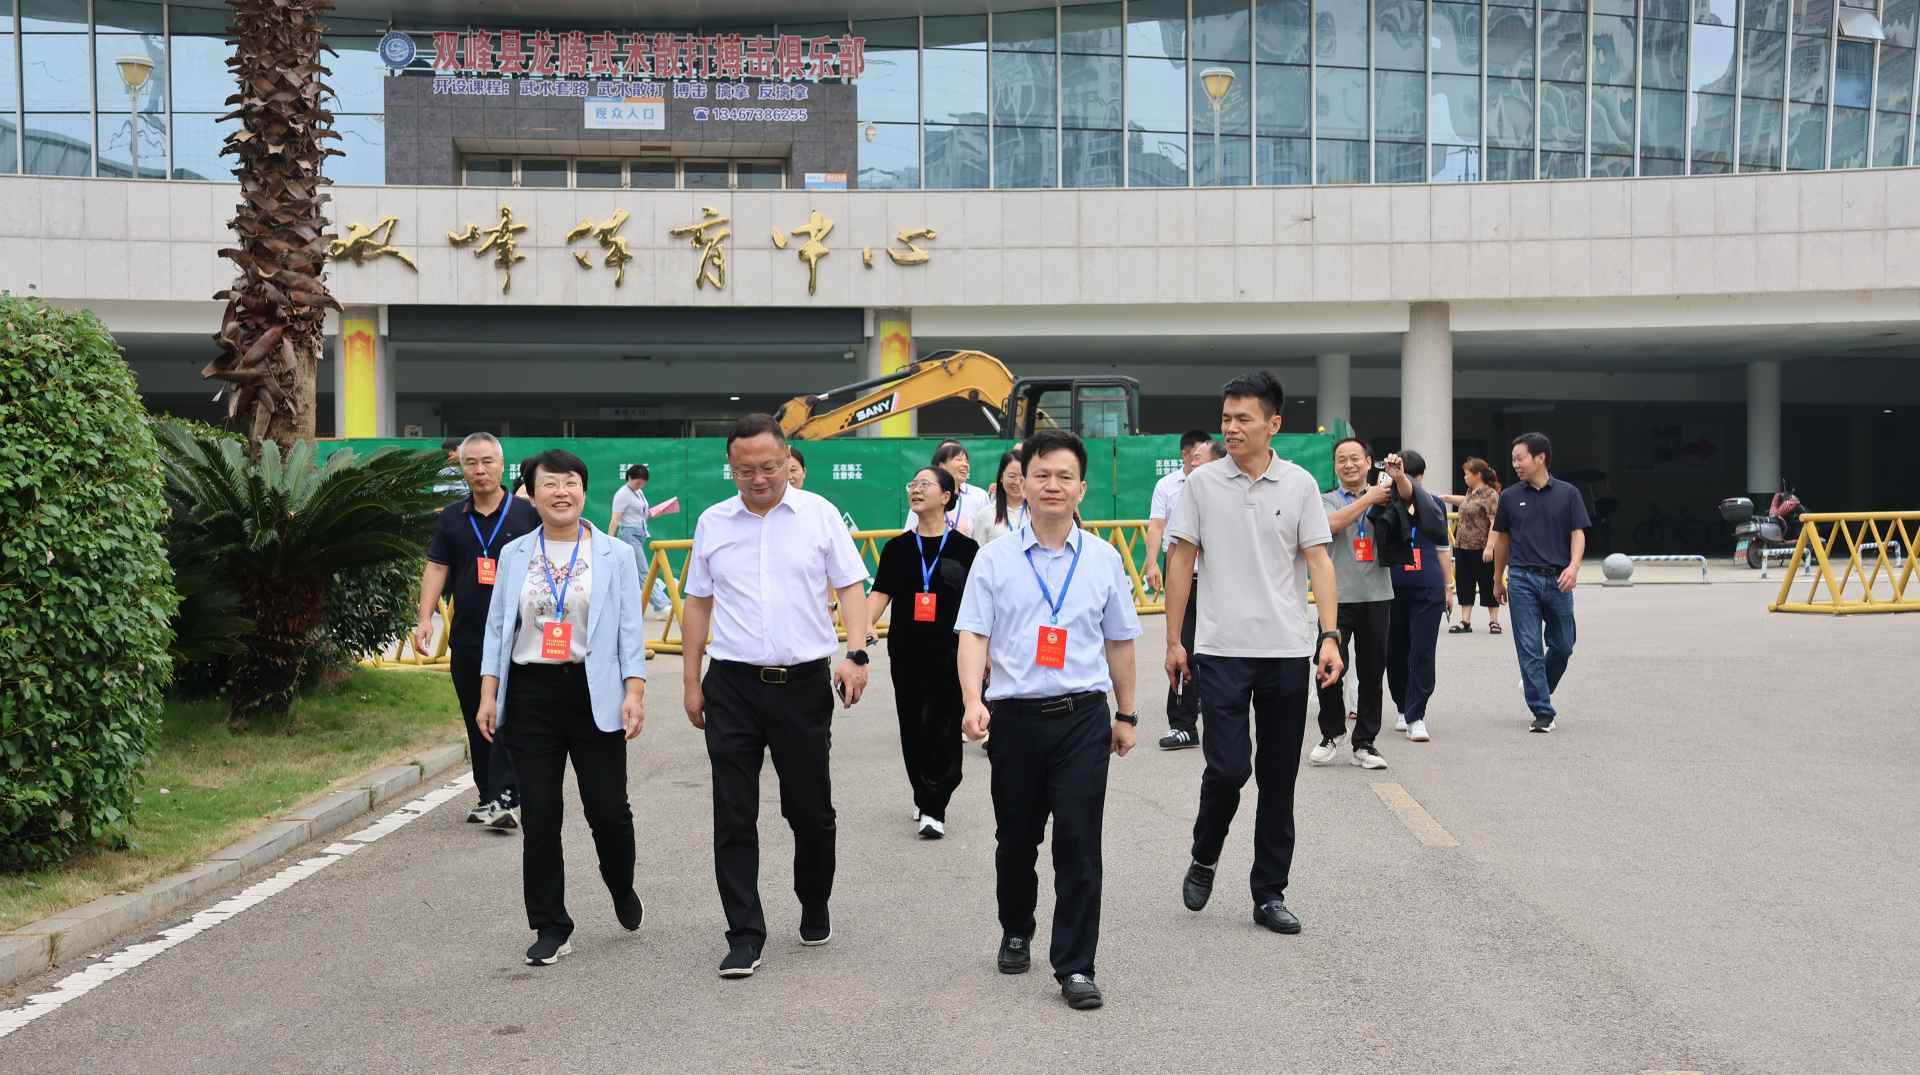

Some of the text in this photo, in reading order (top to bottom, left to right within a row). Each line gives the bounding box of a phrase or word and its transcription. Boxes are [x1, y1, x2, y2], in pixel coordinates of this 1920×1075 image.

[432, 29, 866, 80] 双峰县龙腾武术散打搏击俱乐部
[519, 80, 588, 96] 武术套路
[597, 81, 665, 97] 武术散打
[855, 399, 890, 422] SANY
